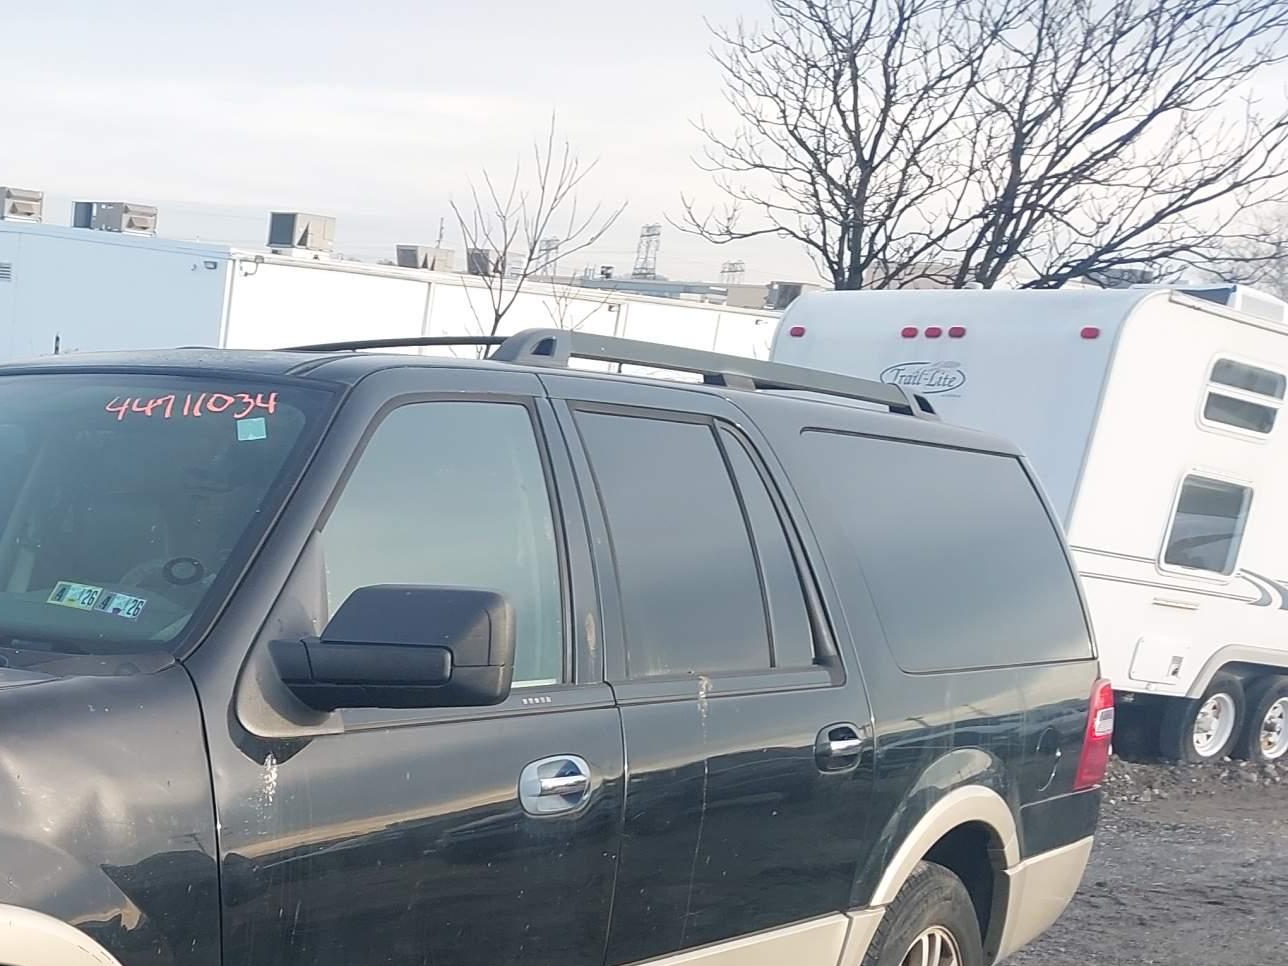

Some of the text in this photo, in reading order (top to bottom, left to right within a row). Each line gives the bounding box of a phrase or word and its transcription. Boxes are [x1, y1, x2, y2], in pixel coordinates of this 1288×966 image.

[889, 367, 957, 387] Trail-Lite
[105, 392, 279, 420] 44711034
[55, 587, 99, 607] 4 26
[99, 595, 145, 617] 4 26
